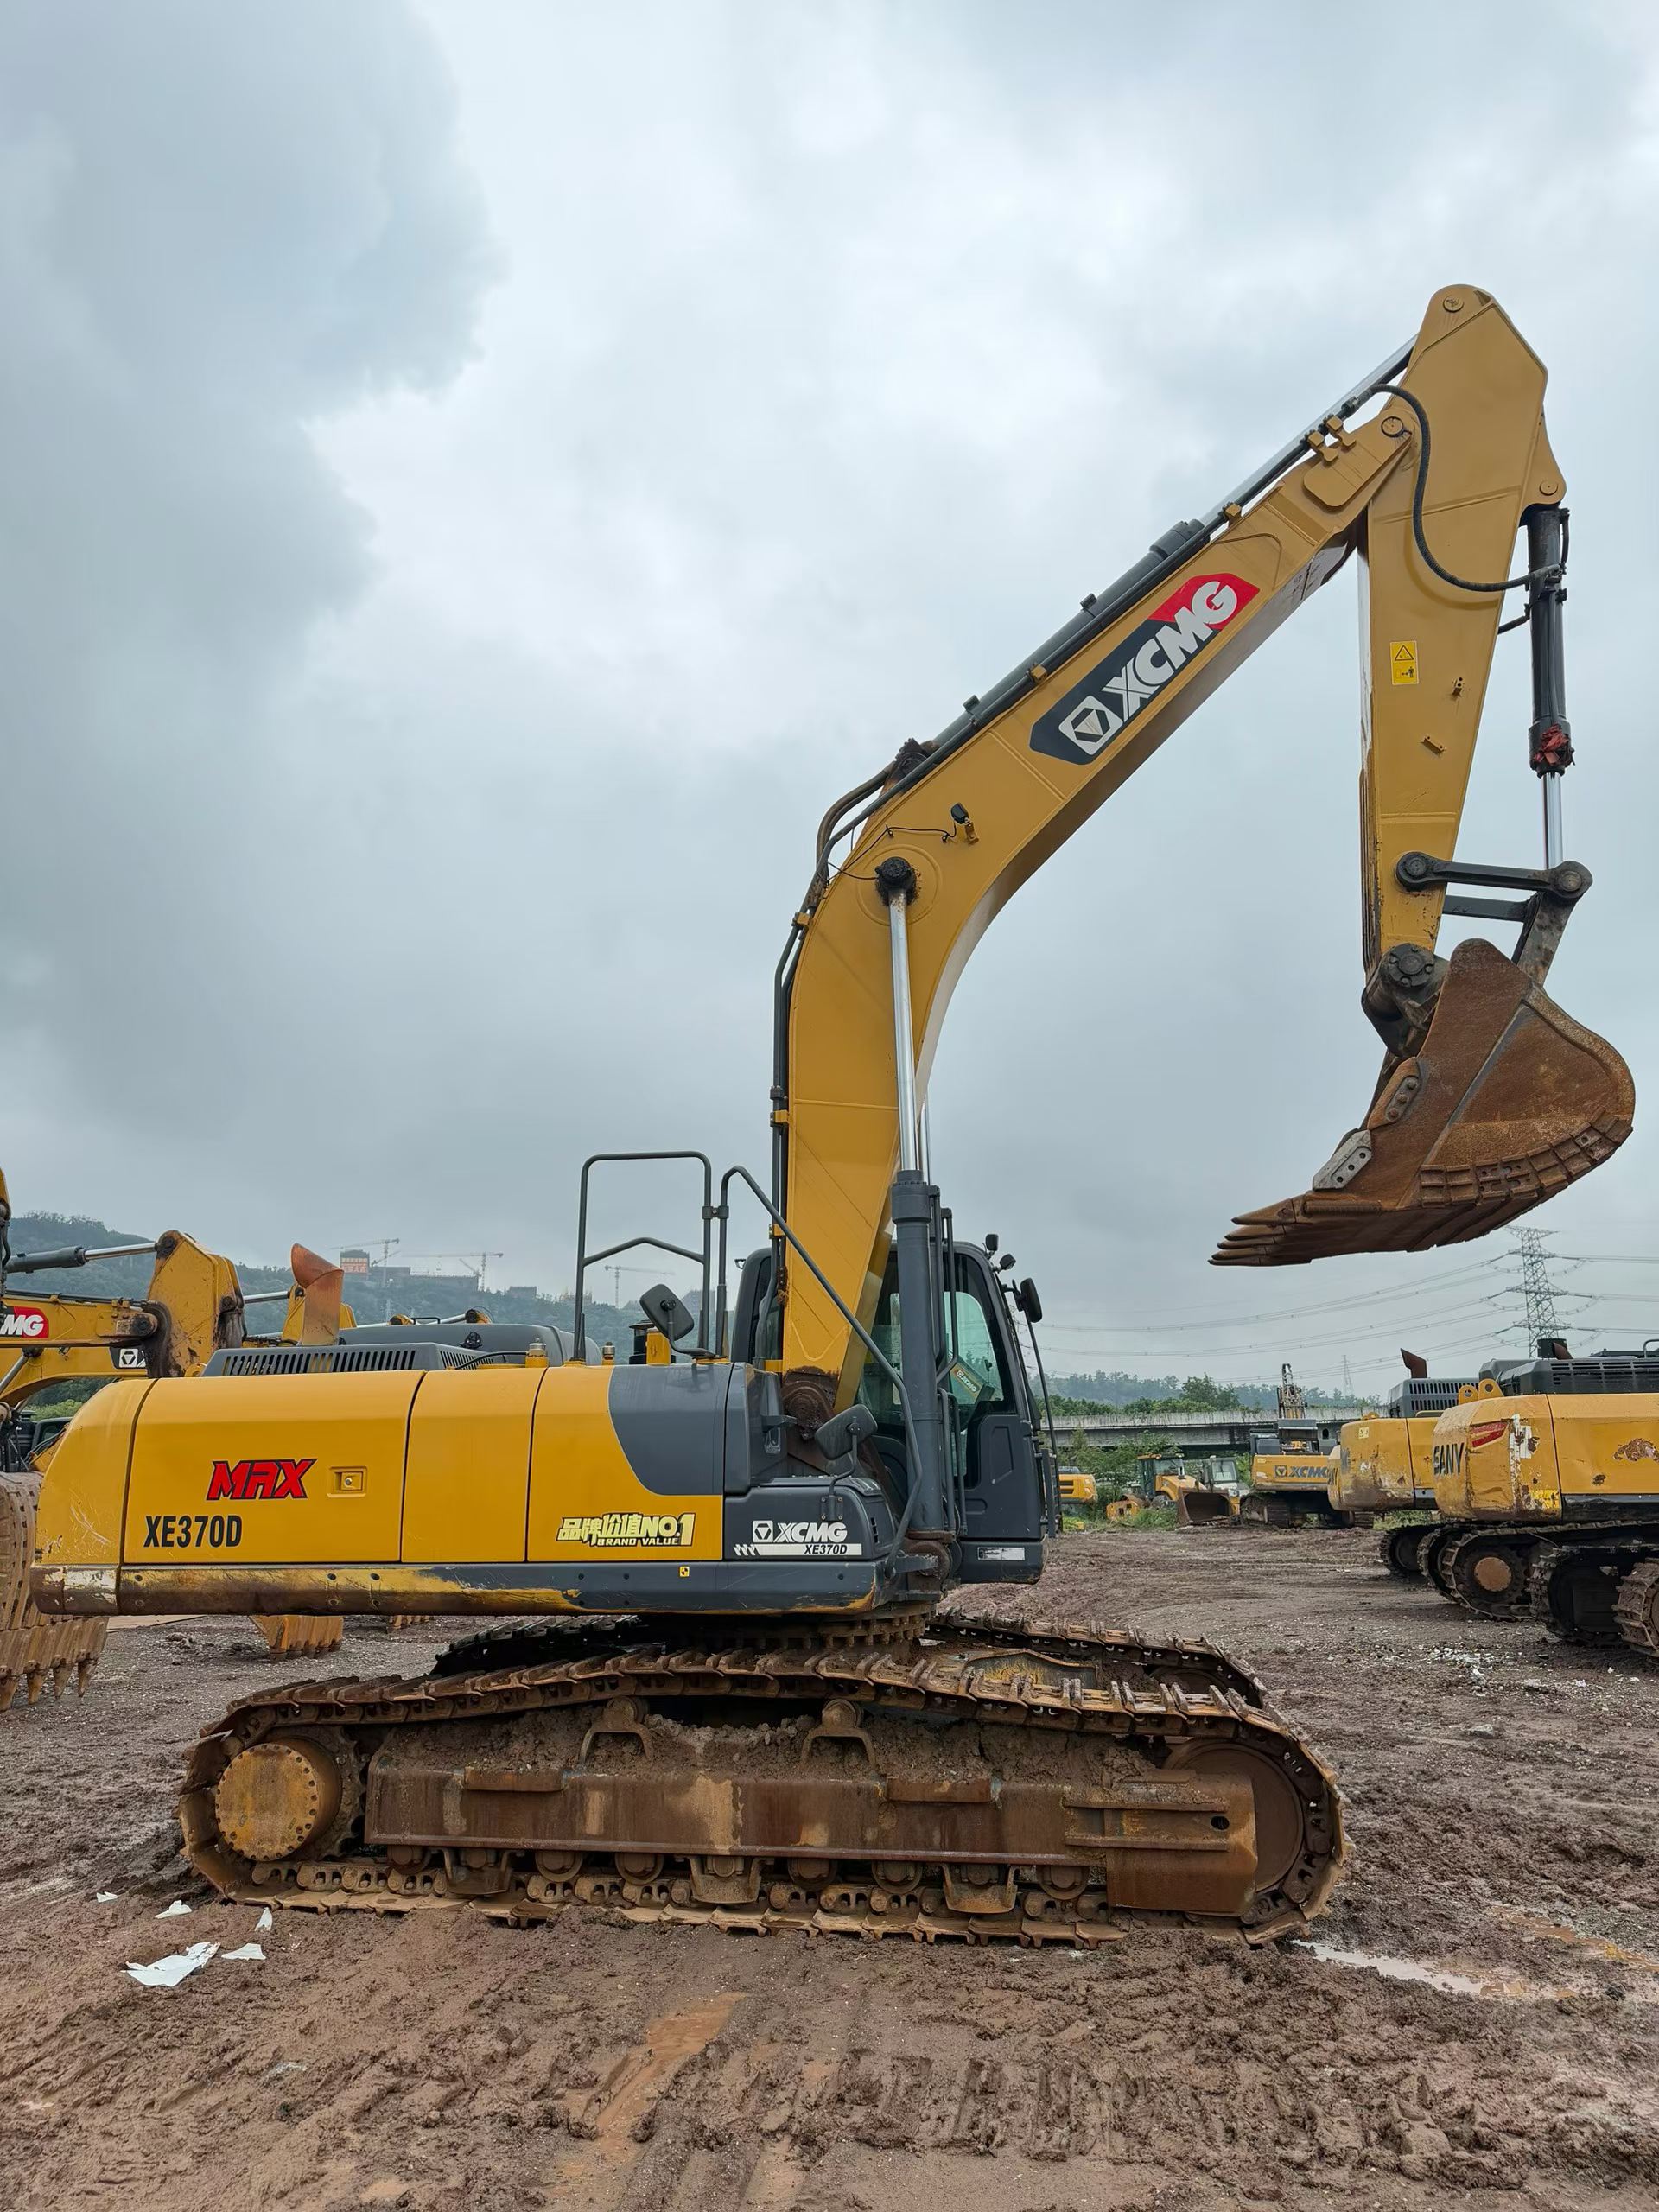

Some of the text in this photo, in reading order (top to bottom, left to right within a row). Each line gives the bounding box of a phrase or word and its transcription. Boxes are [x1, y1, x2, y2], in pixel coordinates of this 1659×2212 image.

[1102, 581, 1237, 722] XCMG
[0, 1314, 44, 1337] MG
[206, 1458, 318, 1501] MAX
[143, 1515, 243, 1548] XE370D
[597, 1537, 679, 1546] BRAND VALUE
[773, 1522, 848, 1543] XCMG
[804, 1544, 848, 1554] XE370D
